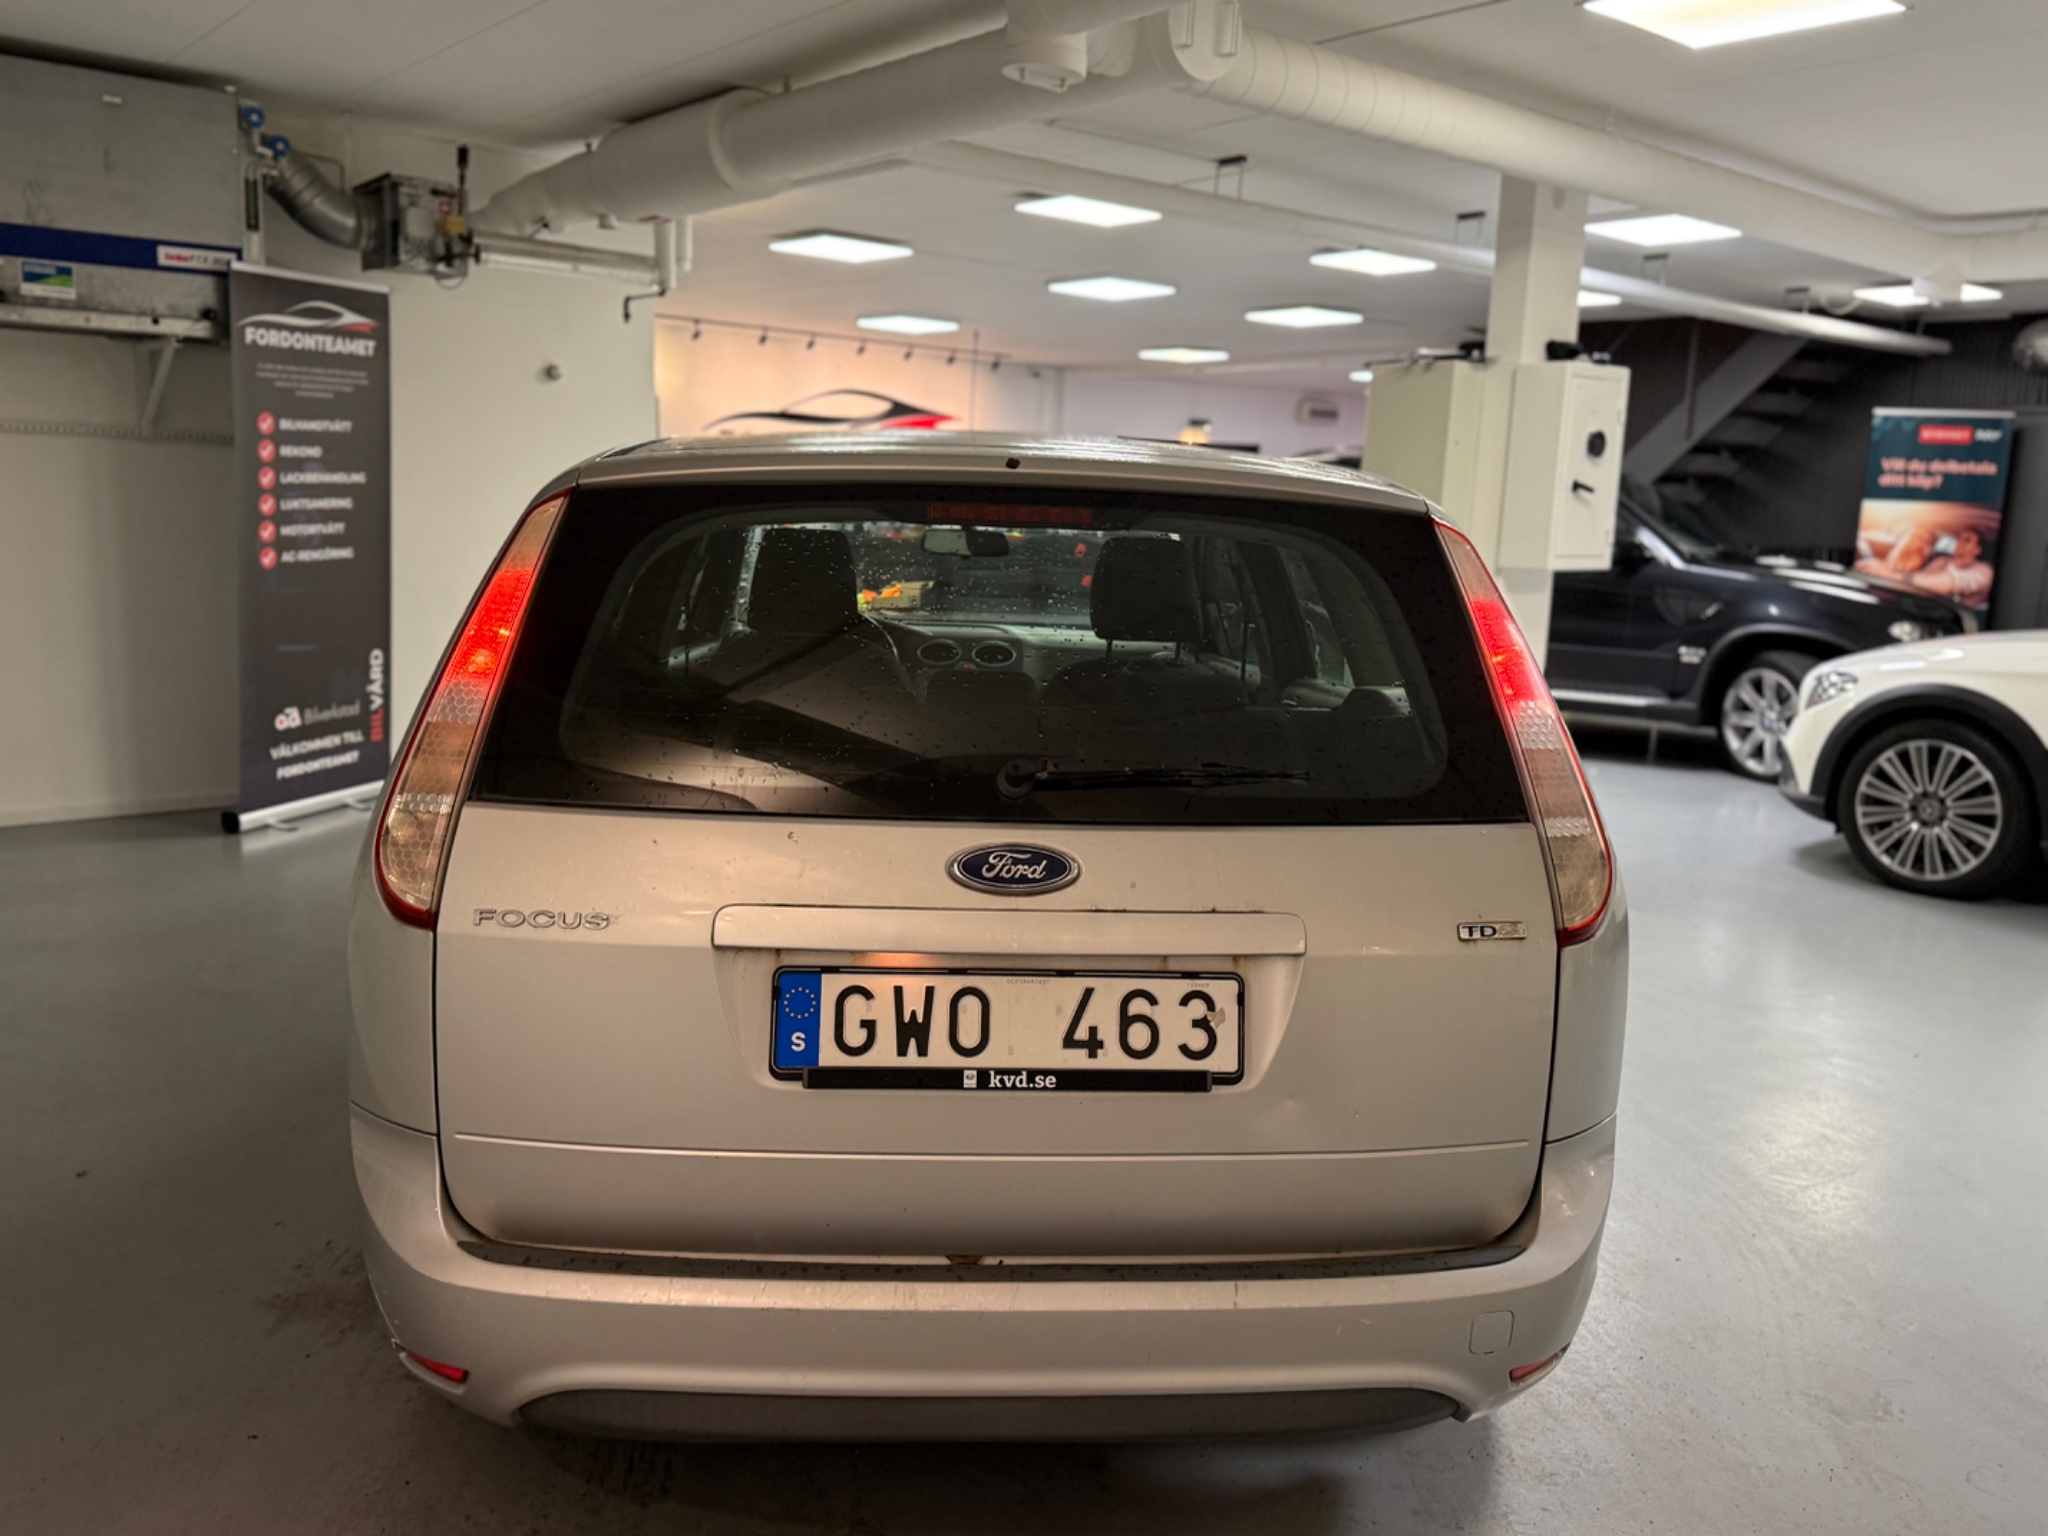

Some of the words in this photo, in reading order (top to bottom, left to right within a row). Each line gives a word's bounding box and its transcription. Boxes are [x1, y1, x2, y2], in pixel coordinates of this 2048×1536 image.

[244, 326, 377, 357] FORDONTEAMET
[279, 445, 323, 458] REKOND
[279, 471, 367, 484] LACKBEHANDLING
[279, 497, 354, 510] LUKTSANERING
[366, 648, 384, 742] BILVÅRD
[269, 733, 341, 760] VÄLKOMMEN
[342, 729, 365, 745] TILL
[276, 750, 360, 780] FORDONTEAMET
[981, 850, 1047, 879] Ford
[473, 908, 611, 931] FOCUS
[834, 985, 991, 1058] GWO
[1062, 987, 1218, 1060] 463
[790, 1031, 806, 1053] S
[987, 1069, 1057, 1089] kvd.se
